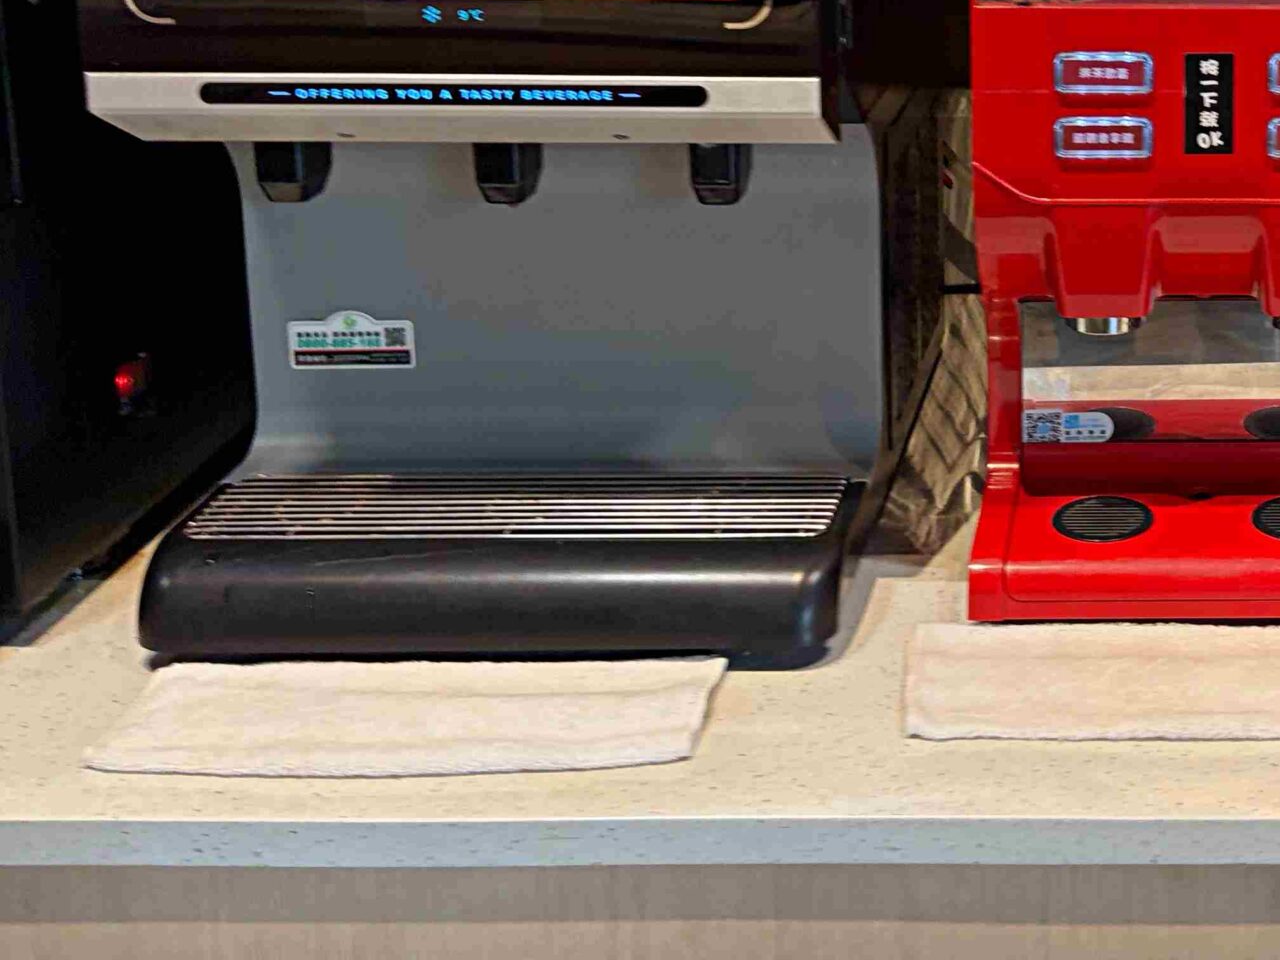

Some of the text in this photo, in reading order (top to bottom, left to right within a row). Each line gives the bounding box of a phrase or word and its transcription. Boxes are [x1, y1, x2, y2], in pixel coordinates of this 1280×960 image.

[294, 88, 614, 101] OFFERING YOU A TASTY BEVERAGE
